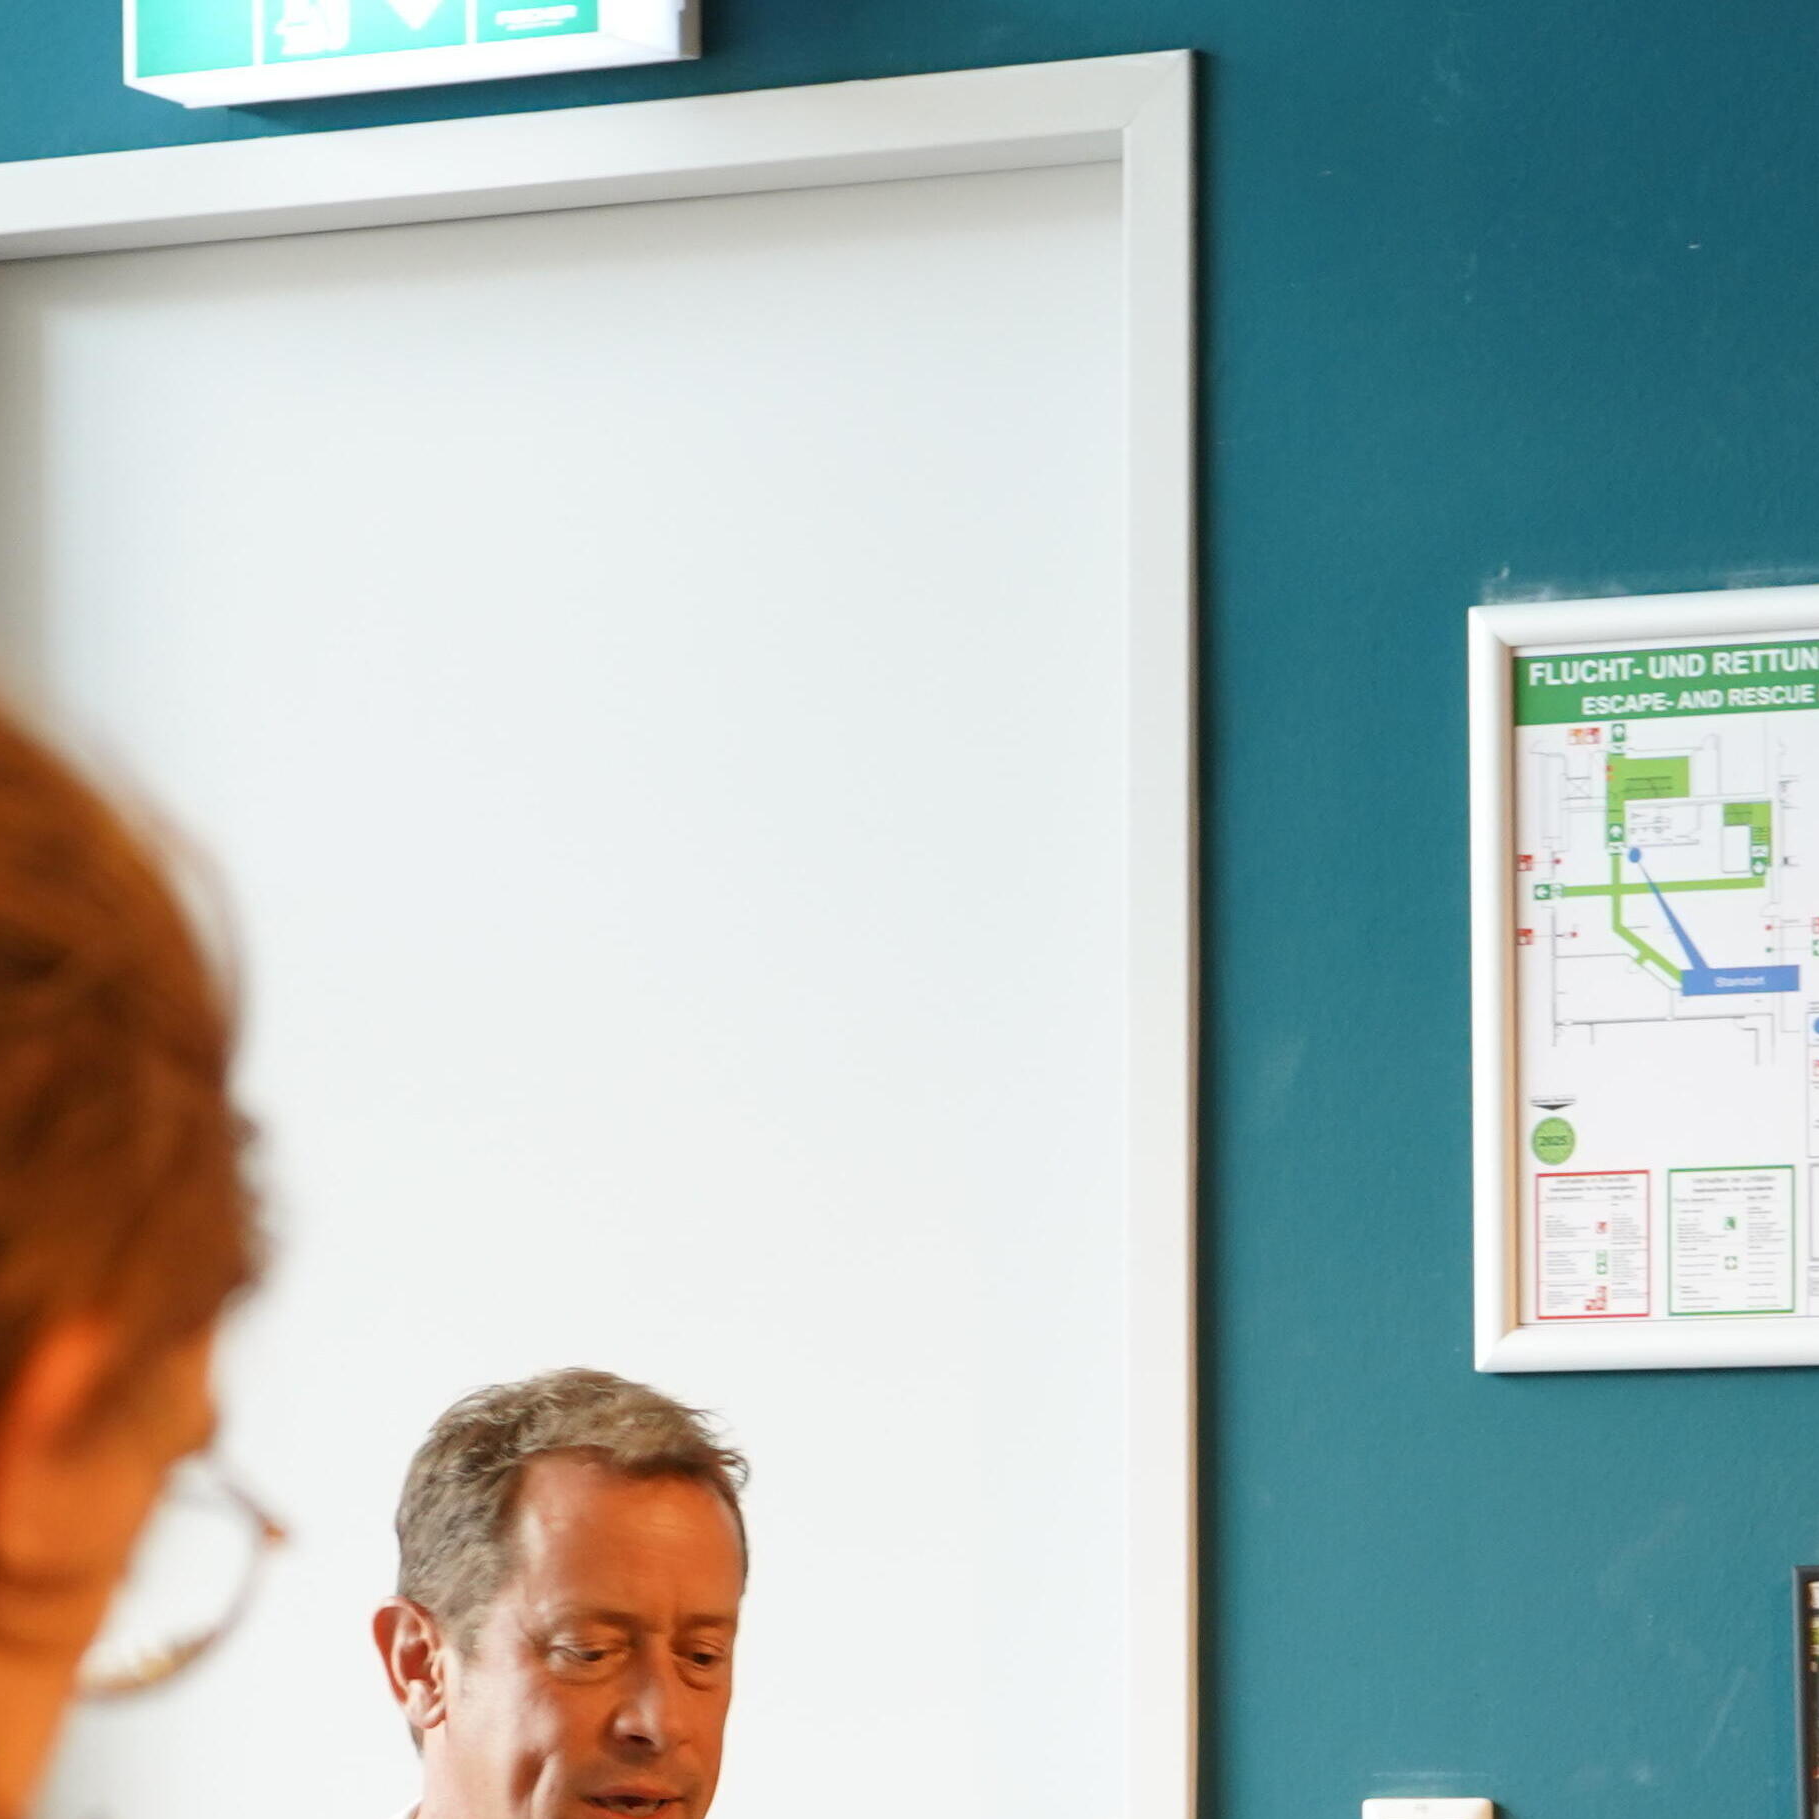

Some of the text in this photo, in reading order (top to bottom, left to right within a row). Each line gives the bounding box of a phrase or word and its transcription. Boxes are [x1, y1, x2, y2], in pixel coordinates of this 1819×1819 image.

[1528, 658, 1643, 687] FLUCHT-
[1648, 652, 1706, 680] UND
[1581, 691, 1675, 716] ESCAPE-
[1678, 687, 1724, 711] AND
[1727, 684, 1815, 707] RESCUE
